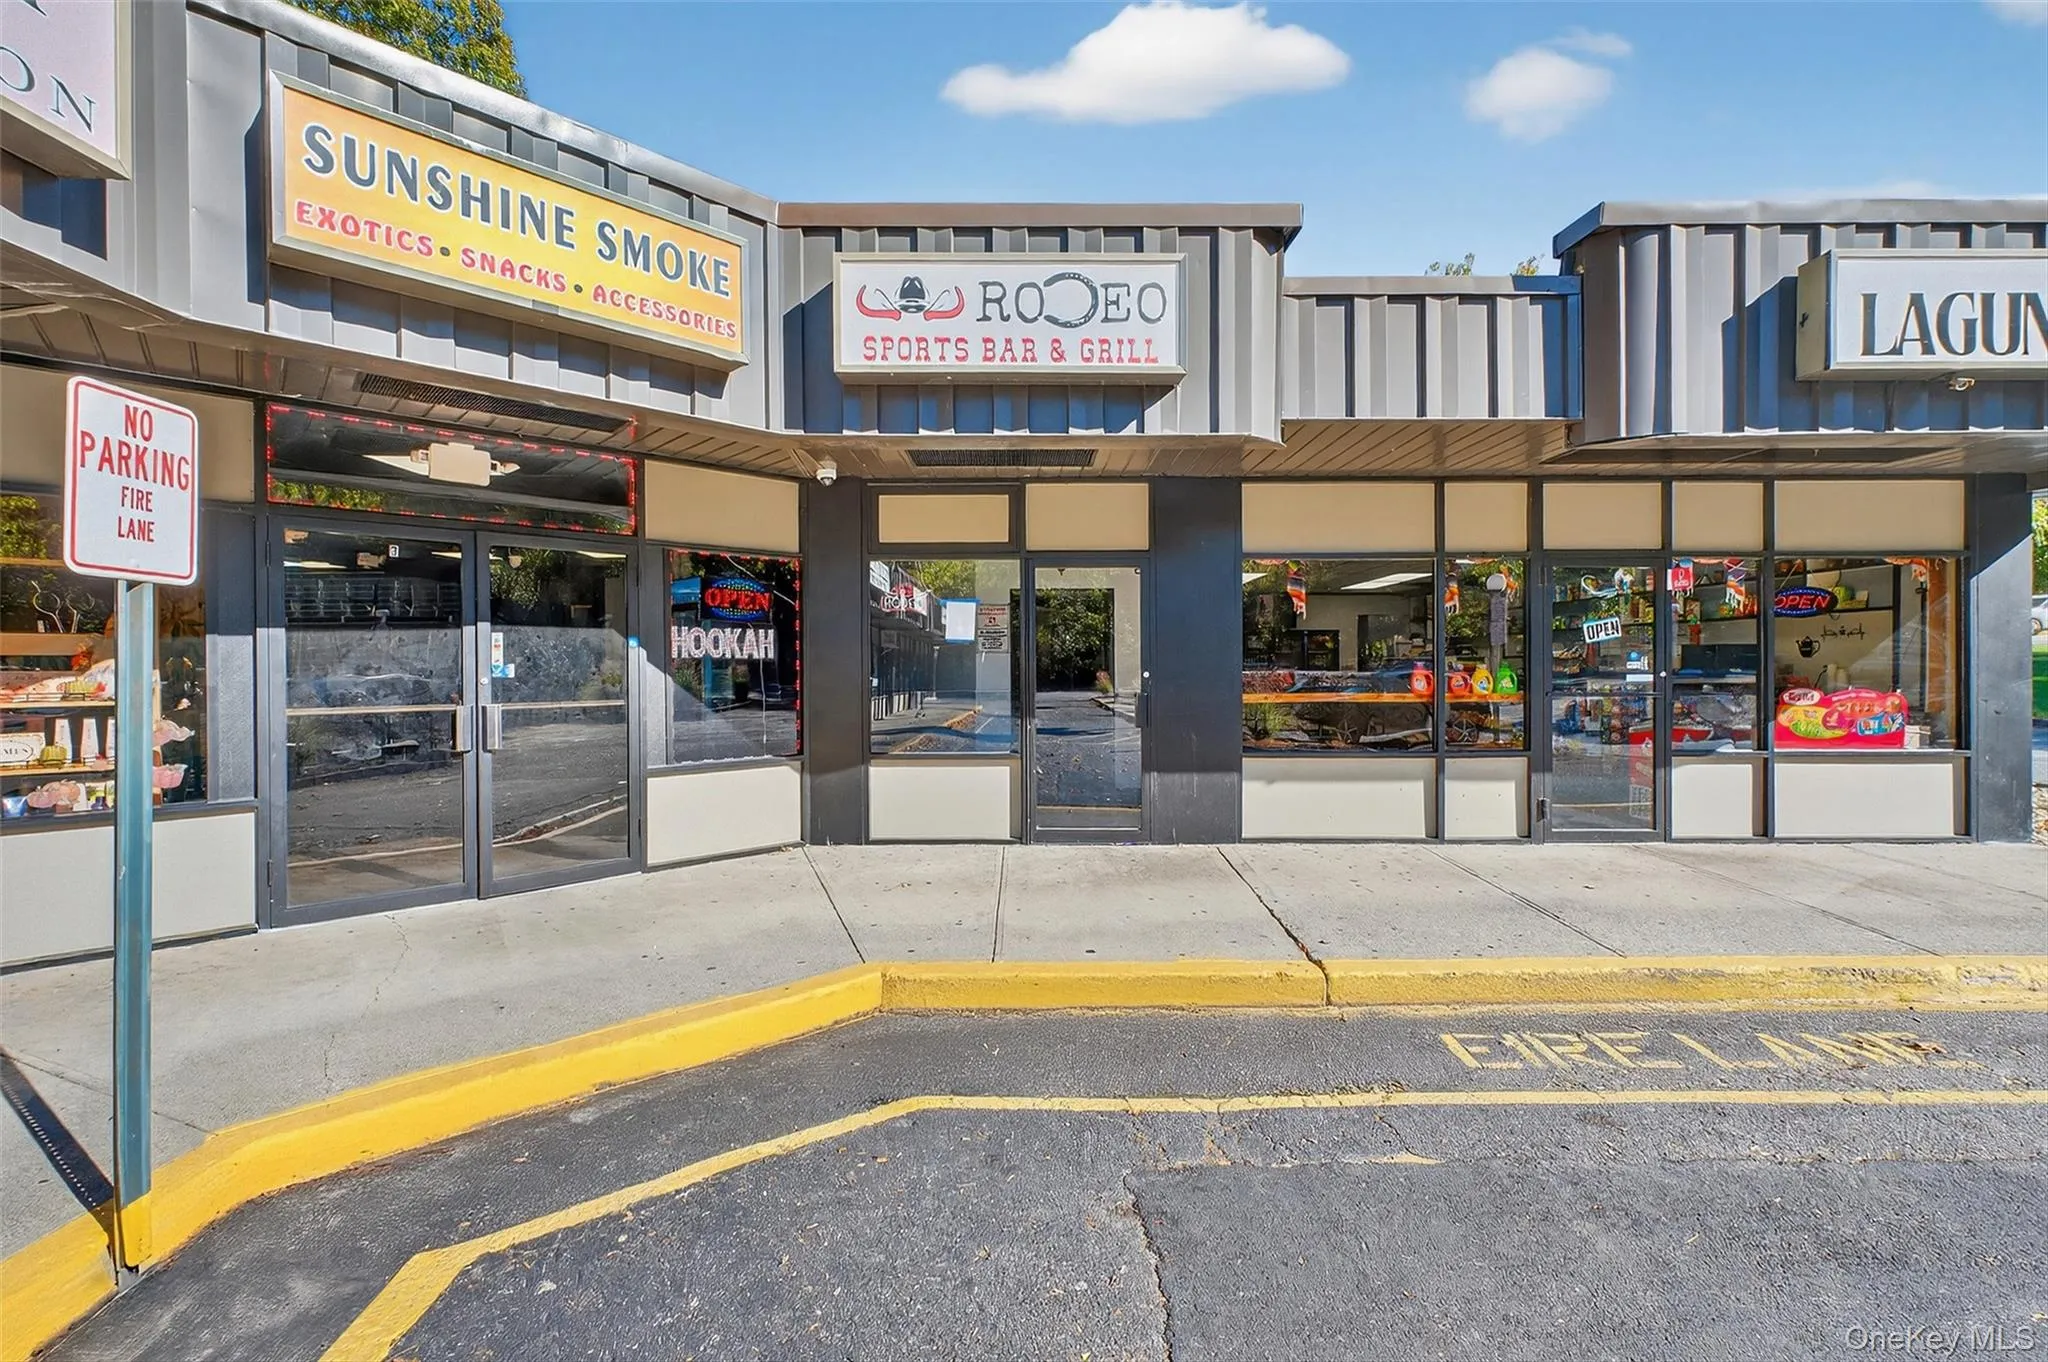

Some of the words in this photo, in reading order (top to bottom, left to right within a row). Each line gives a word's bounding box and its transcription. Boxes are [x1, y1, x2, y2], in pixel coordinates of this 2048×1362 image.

[303, 123, 576, 250] SUNSHINE
[596, 220, 731, 298] SMOKE
[296, 200, 434, 258] EXOTICS
[461, 247, 567, 293] SNACKS
[592, 284, 737, 340] ACCESSORIES
[863, 335, 969, 363] SPORTS
[981, 336, 1038, 363] BAR
[1050, 337, 1067, 363] &
[1079, 337, 1159, 364] GRILL
[124, 404, 154, 442] NO
[80, 430, 190, 491] PARKING
[121, 486, 153, 512] FIRE
[117, 516, 155, 542] LANE
[704, 588, 771, 612] OPEN
[1774, 594, 1831, 609] OPEN
[671, 625, 774, 659] HOOKAH
[1586, 619, 1620, 641] OPEN
